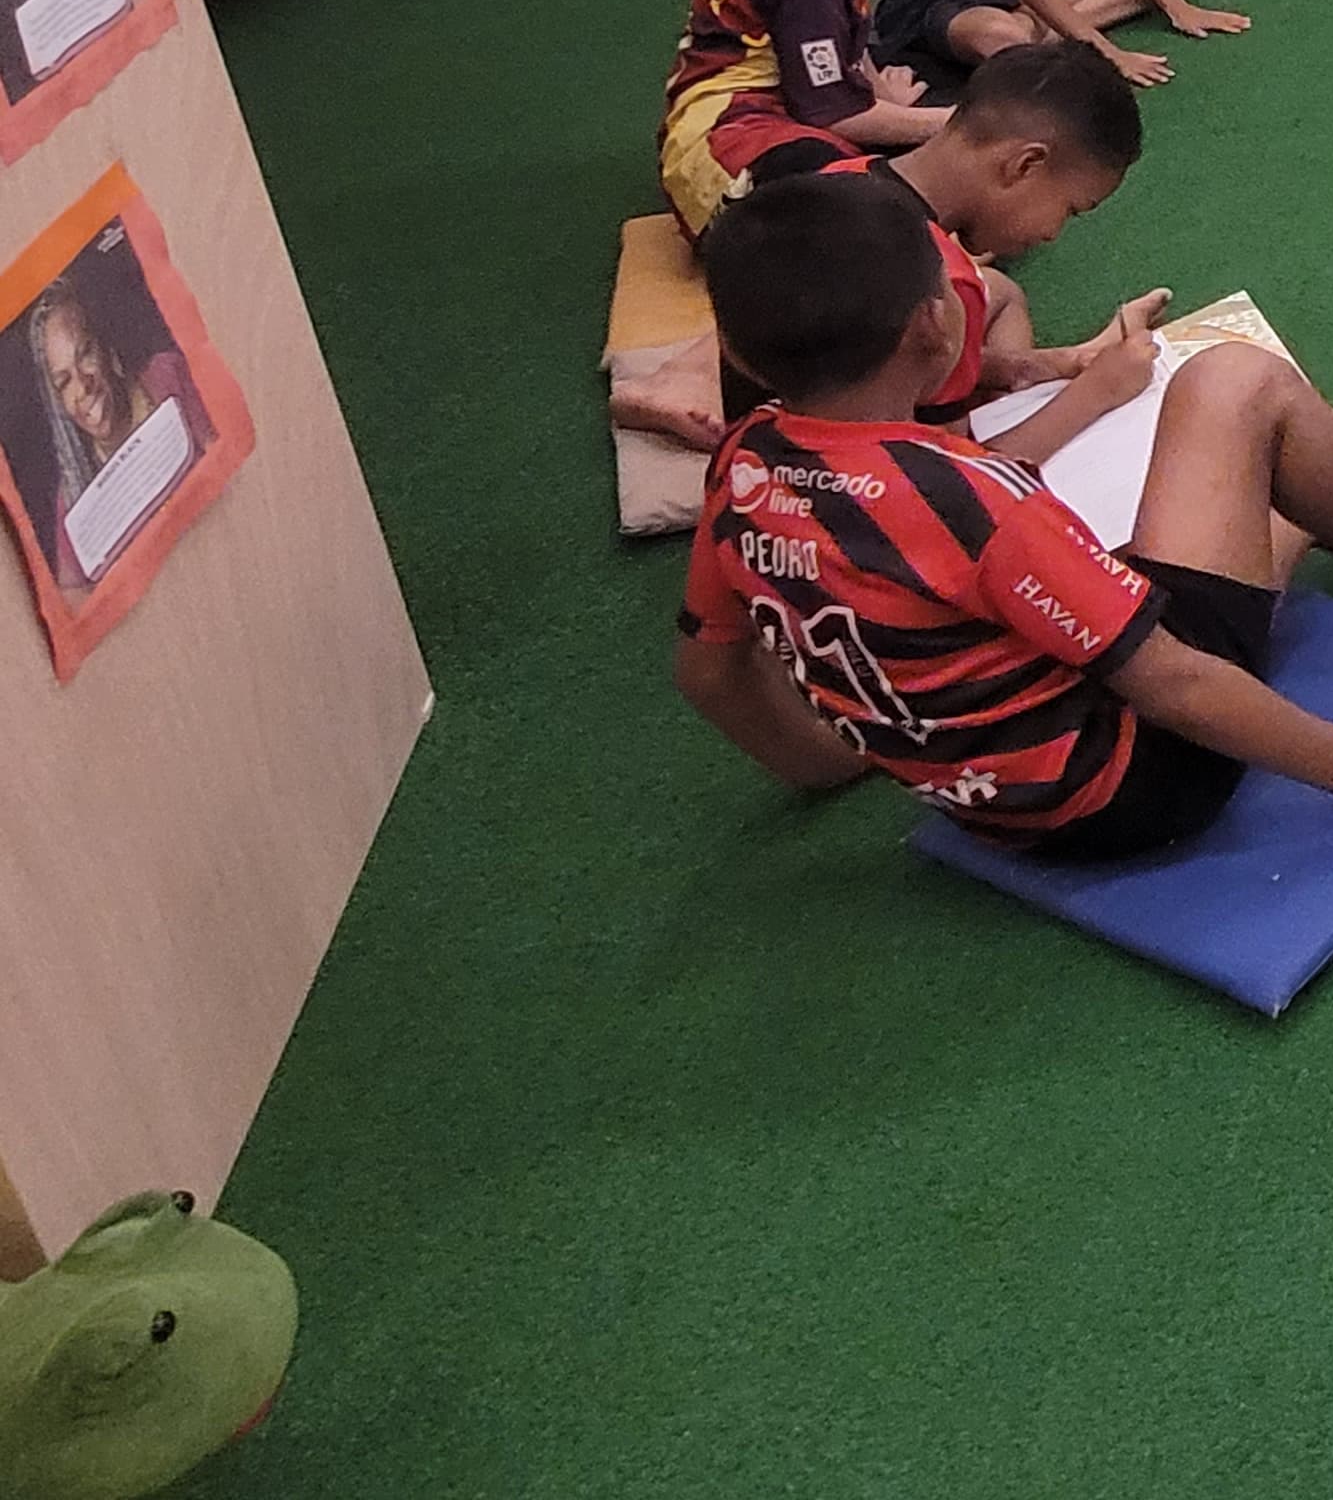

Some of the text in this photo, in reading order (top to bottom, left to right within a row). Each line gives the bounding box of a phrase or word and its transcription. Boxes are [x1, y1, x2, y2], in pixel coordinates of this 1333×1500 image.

[768, 489, 813, 518] livre
[772, 464, 887, 500] mercado
[740, 530, 820, 581] PEDRO
[1013, 574, 1101, 651] HAVAN
